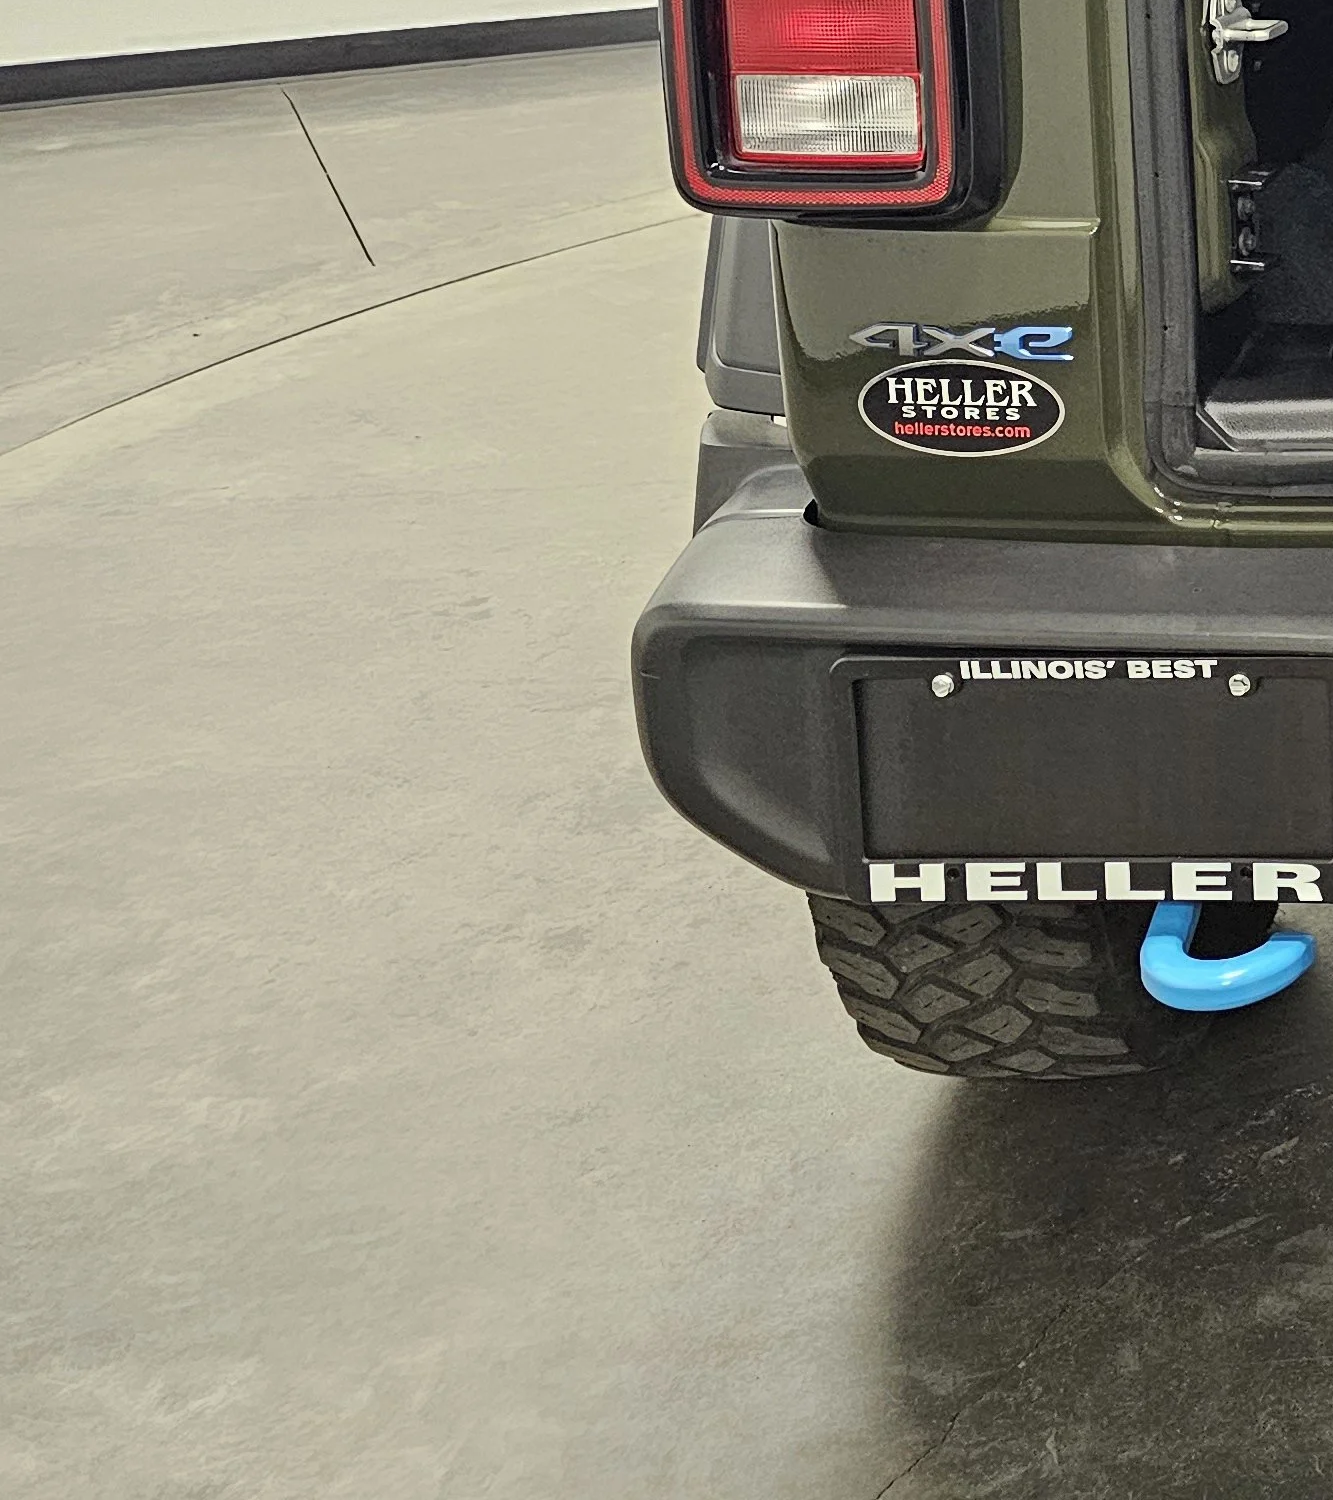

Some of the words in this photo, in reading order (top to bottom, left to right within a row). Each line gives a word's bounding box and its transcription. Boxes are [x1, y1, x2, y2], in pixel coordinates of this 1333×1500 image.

[885, 376, 1038, 407] HELLER
[901, 405, 1021, 421] STORES
[894, 421, 1031, 438] hellerstores.com
[959, 659, 1116, 681] ILLINOIS'
[1126, 659, 1219, 680] BEST
[868, 861, 1324, 902] HELLER
